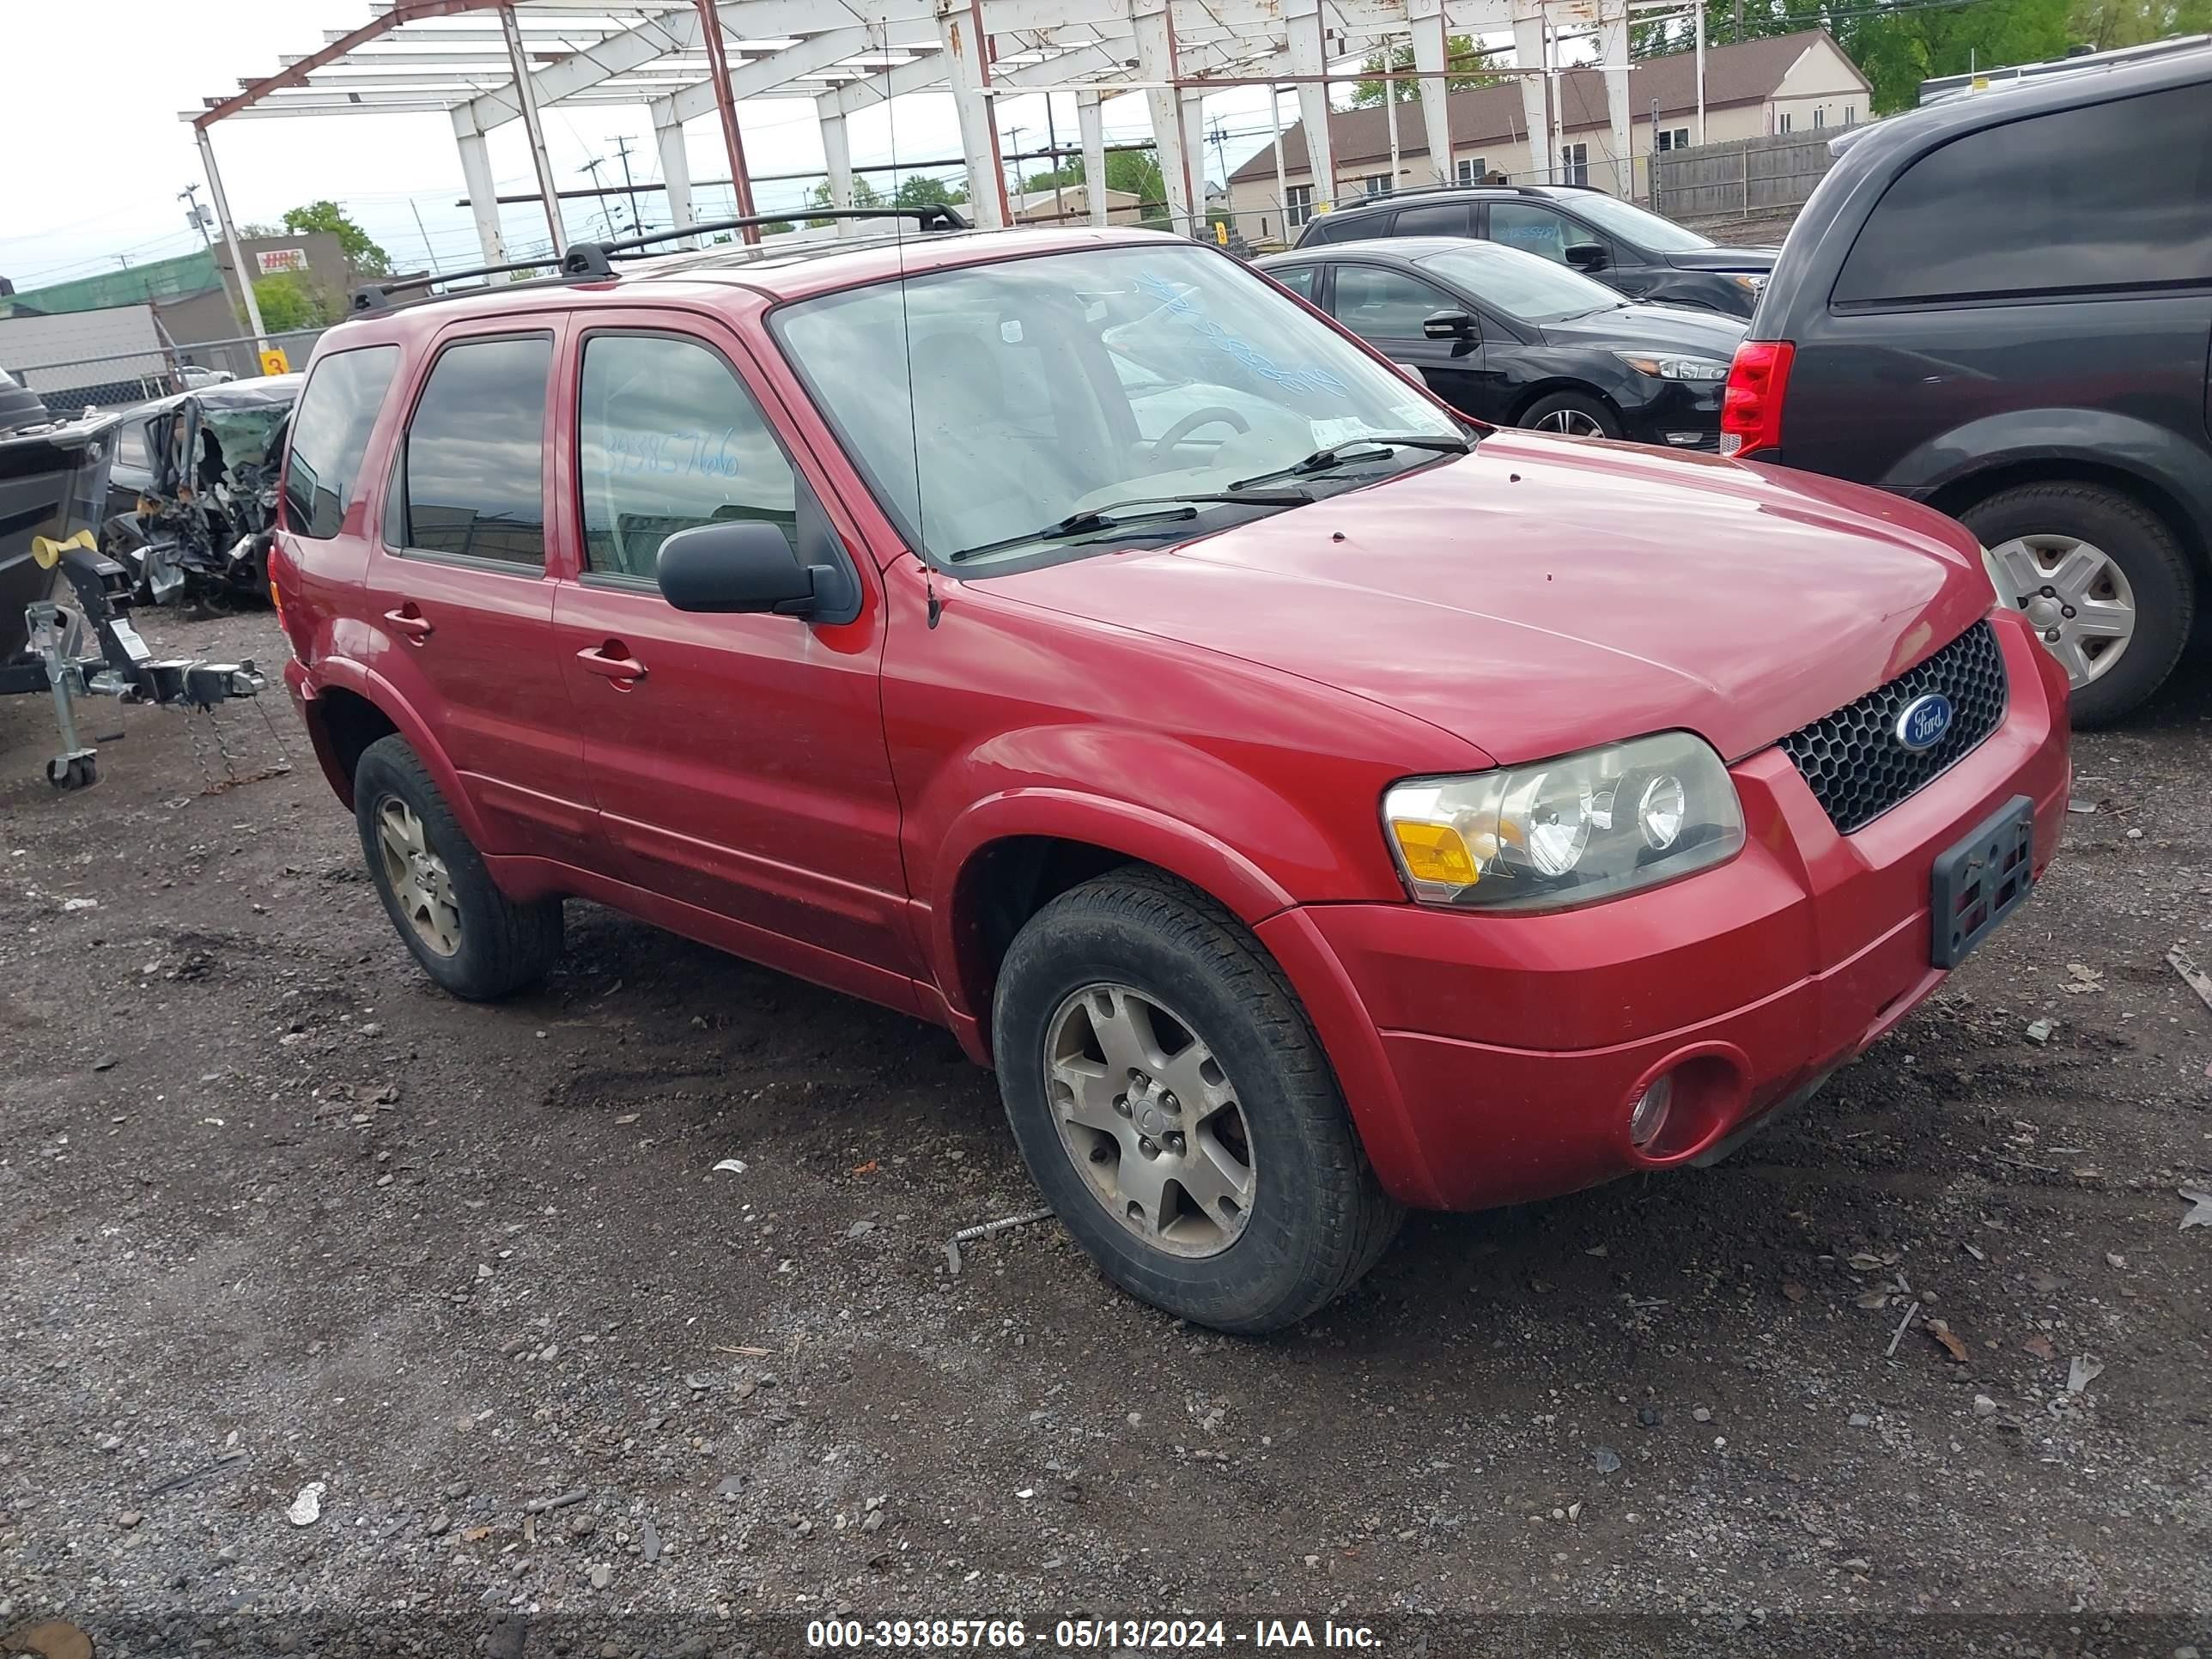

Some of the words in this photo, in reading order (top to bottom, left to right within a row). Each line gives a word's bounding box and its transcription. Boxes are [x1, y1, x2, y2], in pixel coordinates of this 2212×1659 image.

[268, 358, 285, 375] 3
[1914, 704, 1944, 740] Ford
[956, 1224, 984, 1238] AUTO
